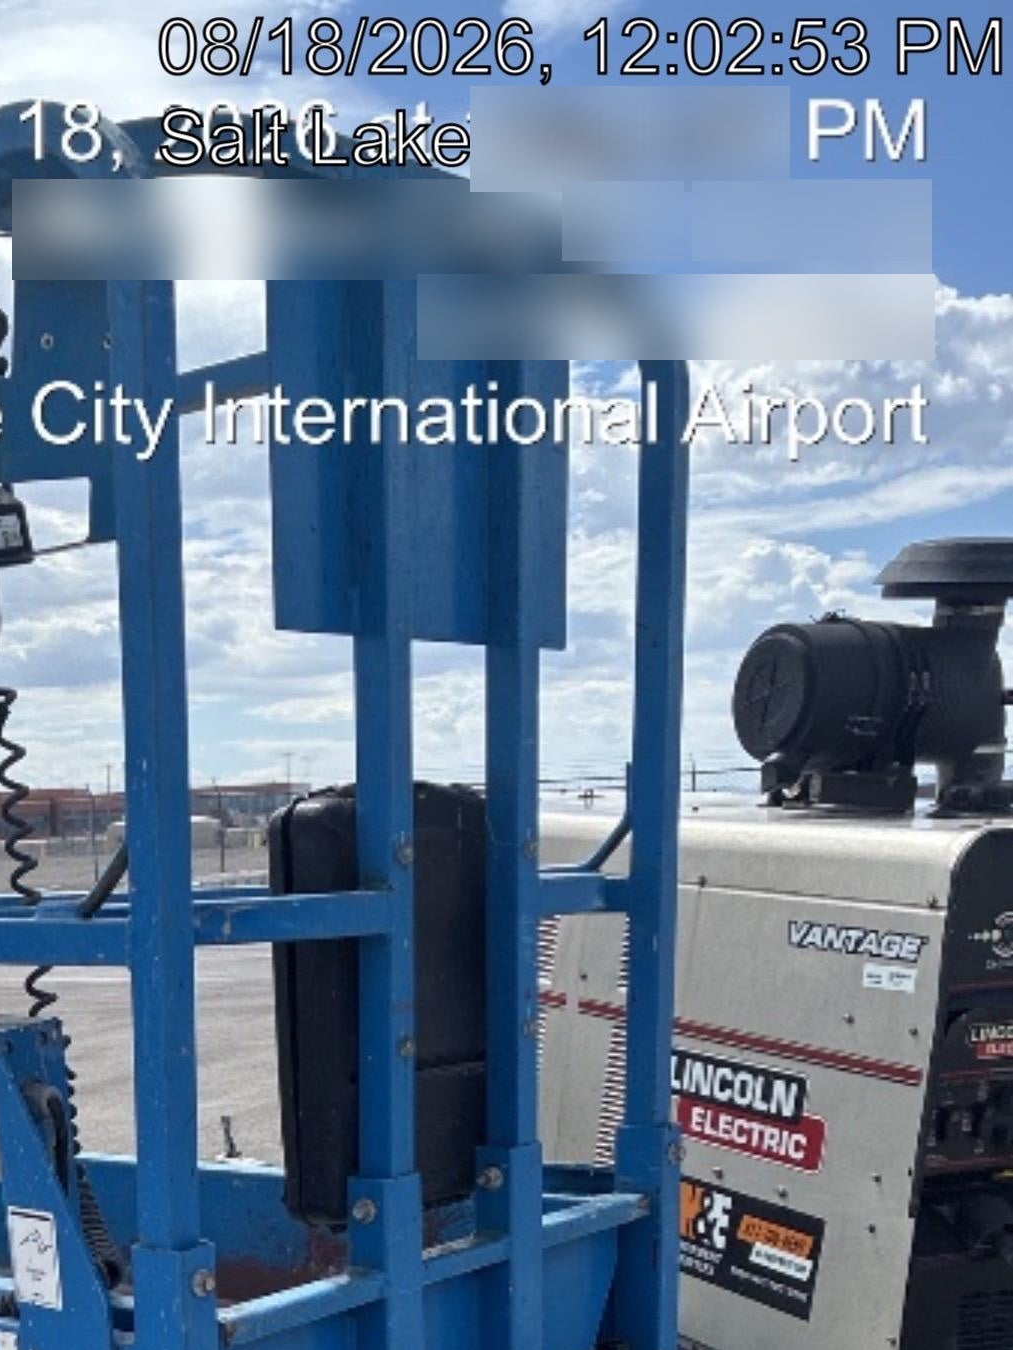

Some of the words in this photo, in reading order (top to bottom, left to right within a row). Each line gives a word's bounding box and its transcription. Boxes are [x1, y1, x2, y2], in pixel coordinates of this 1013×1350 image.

[789, 921, 923, 963] VANTAGE
[671, 1055, 799, 1118] LINCOLN
[691, 1106, 807, 1160] ELECTRIC
